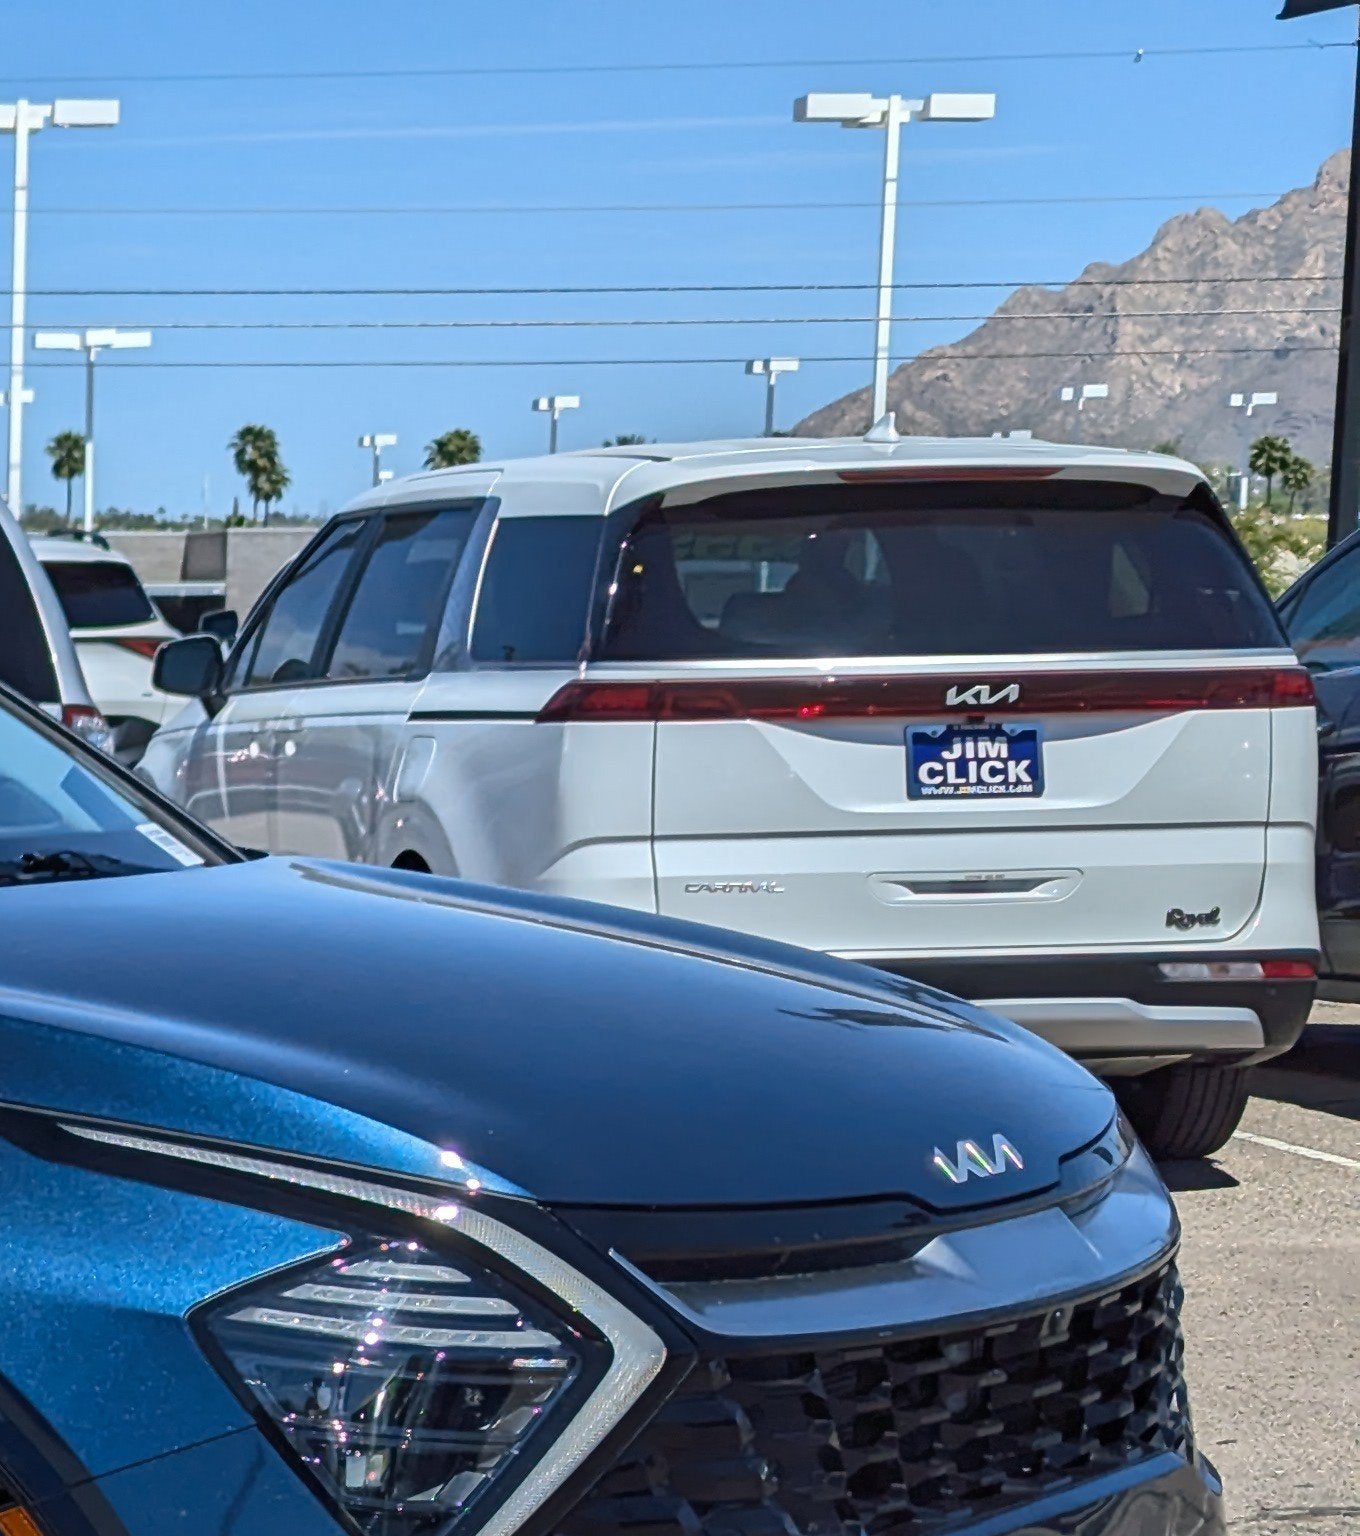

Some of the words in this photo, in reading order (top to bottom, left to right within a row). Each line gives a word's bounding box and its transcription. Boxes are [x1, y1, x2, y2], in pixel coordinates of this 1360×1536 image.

[945, 683, 1020, 706] KIA
[941, 736, 1009, 760] JIM
[918, 759, 1033, 785] CLICK
[933, 1133, 1024, 1184] KIA
